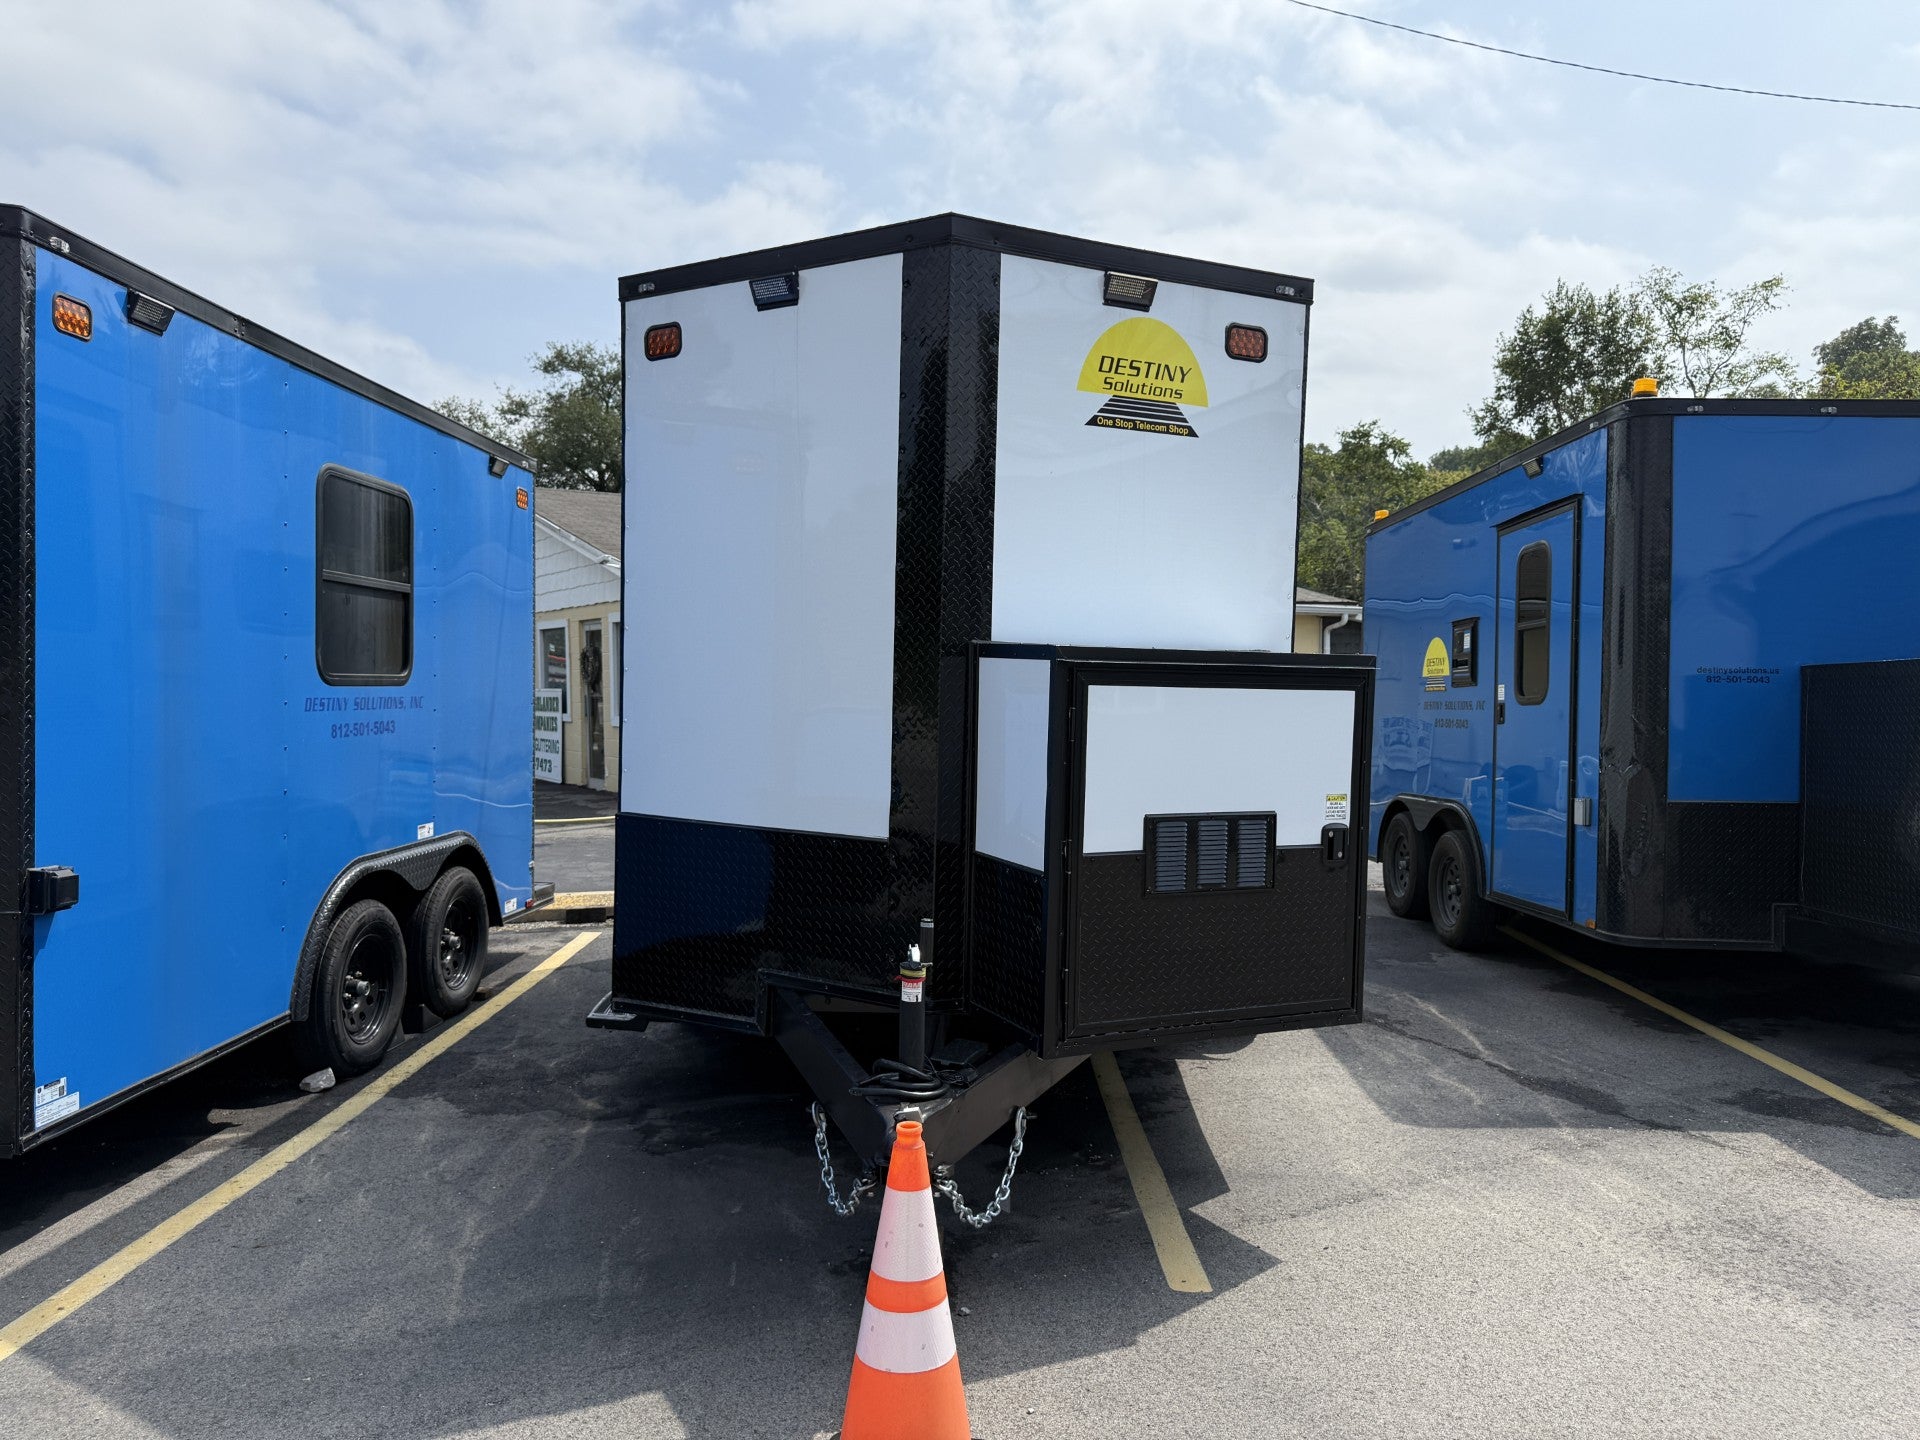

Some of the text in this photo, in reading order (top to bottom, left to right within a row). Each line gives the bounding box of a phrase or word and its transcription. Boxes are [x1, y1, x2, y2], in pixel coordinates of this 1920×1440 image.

[1098, 355, 1192, 383] DESTINY
[1102, 376, 1183, 399] Solutions
[1097, 416, 1189, 435] One Stop Telecom Shop
[1696, 666, 1780, 675] destinysolutions.us
[1706, 675, 1770, 684] 812-501-5043
[304, 696, 424, 712] DESTINY SOLUTIONS, INC
[331, 720, 396, 739] 812-501-5043
